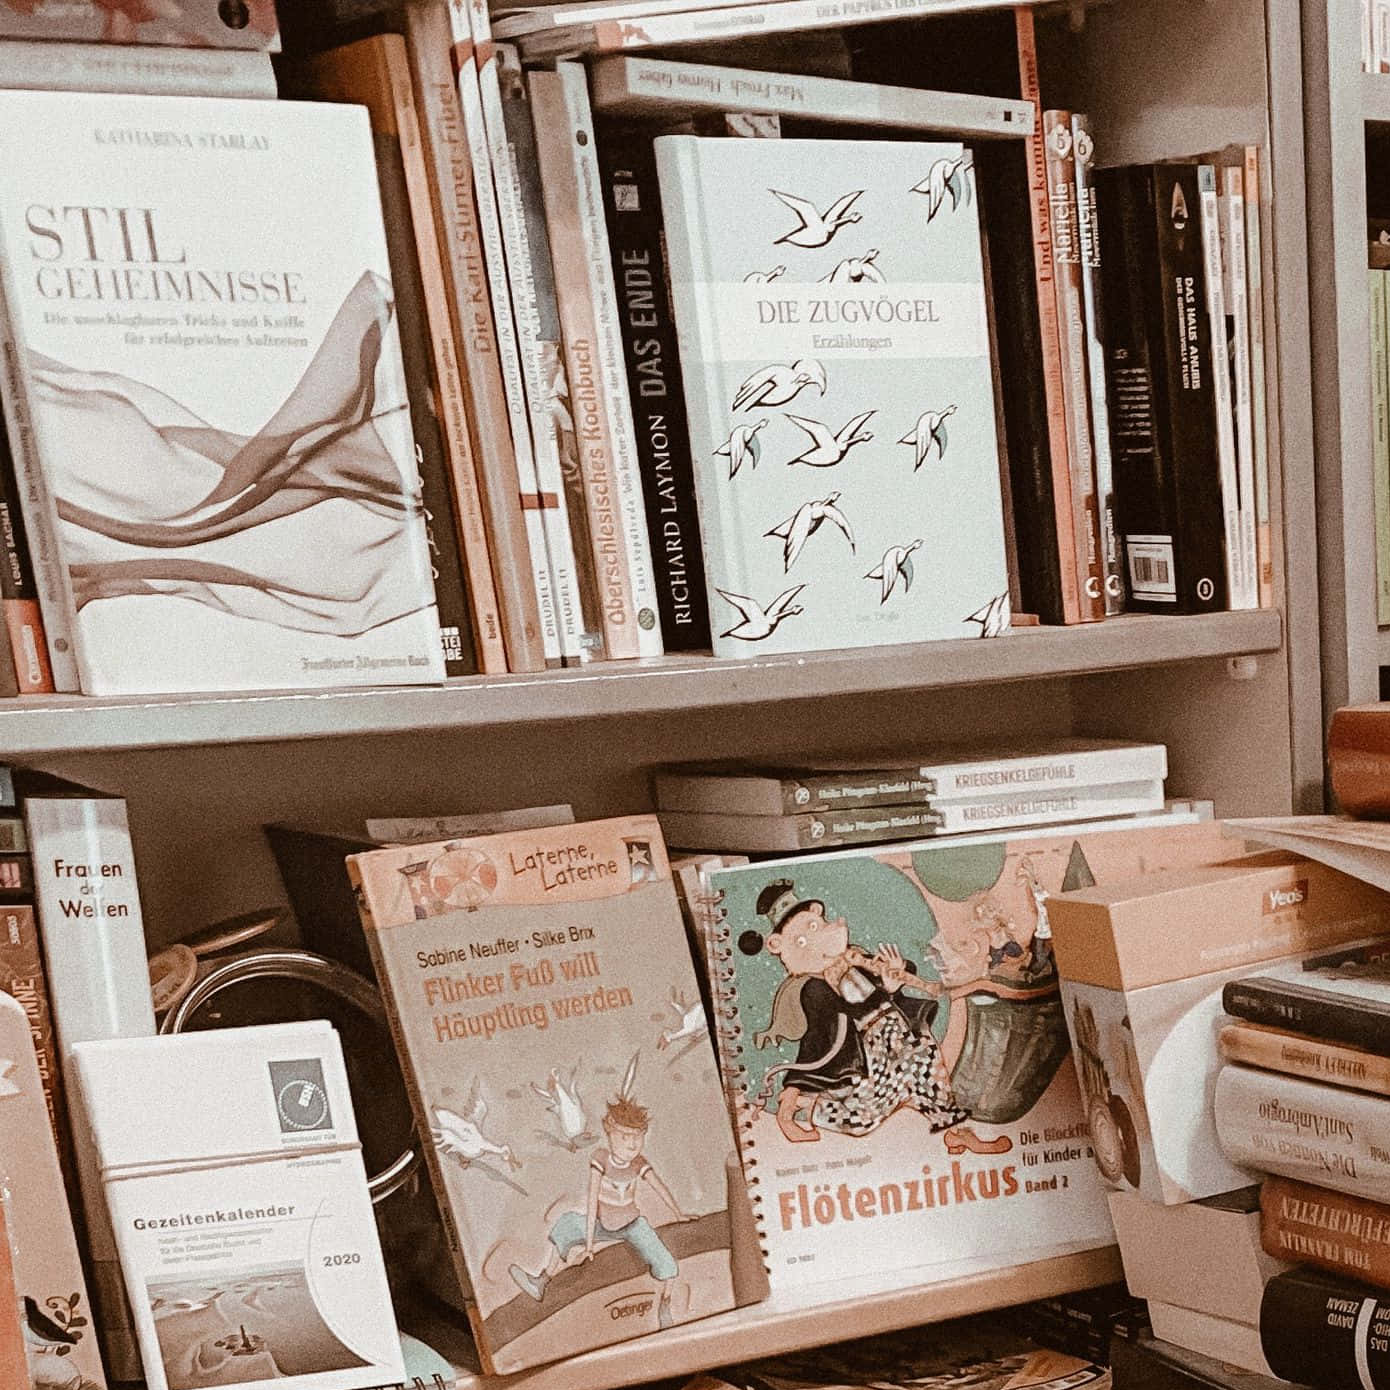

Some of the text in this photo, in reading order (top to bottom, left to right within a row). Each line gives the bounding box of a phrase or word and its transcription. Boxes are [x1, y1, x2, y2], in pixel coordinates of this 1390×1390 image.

[24, 203, 187, 264] STIL
[1034, 198, 1053, 282] Und was
[34, 266, 307, 303] GEHEIMNISSE
[756, 294, 940, 325] DIE ZUGVÖGEL
[1183, 276, 1201, 390] DAS HAUS ANUBIS
[620, 247, 693, 625] RICHARD LAYMON DAS ENDE
[570, 339, 626, 627] Oberschlesisches Kochbuch
[541, 860, 619, 889] Laterne
[416, 943, 468, 969] Sabine
[530, 927, 565, 949] Silke
[568, 922, 596, 943] Brix
[422, 949, 601, 1007] Flinker Fuß will
[432, 980, 633, 1049] Häuptling werden
[1021, 1144, 1081, 1167] für Kinder
[777, 1152, 1020, 1230] Flötenzirkus
[1024, 1174, 1058, 1195] Band
[132, 1202, 296, 1232] Gezeitenkalender
[322, 1250, 361, 1268] 2020
[1325, 1295, 1359, 1315] ZEMAN
[1325, 1311, 1355, 1329] DAVID
[1368, 1335, 1390, 1352] DAS
